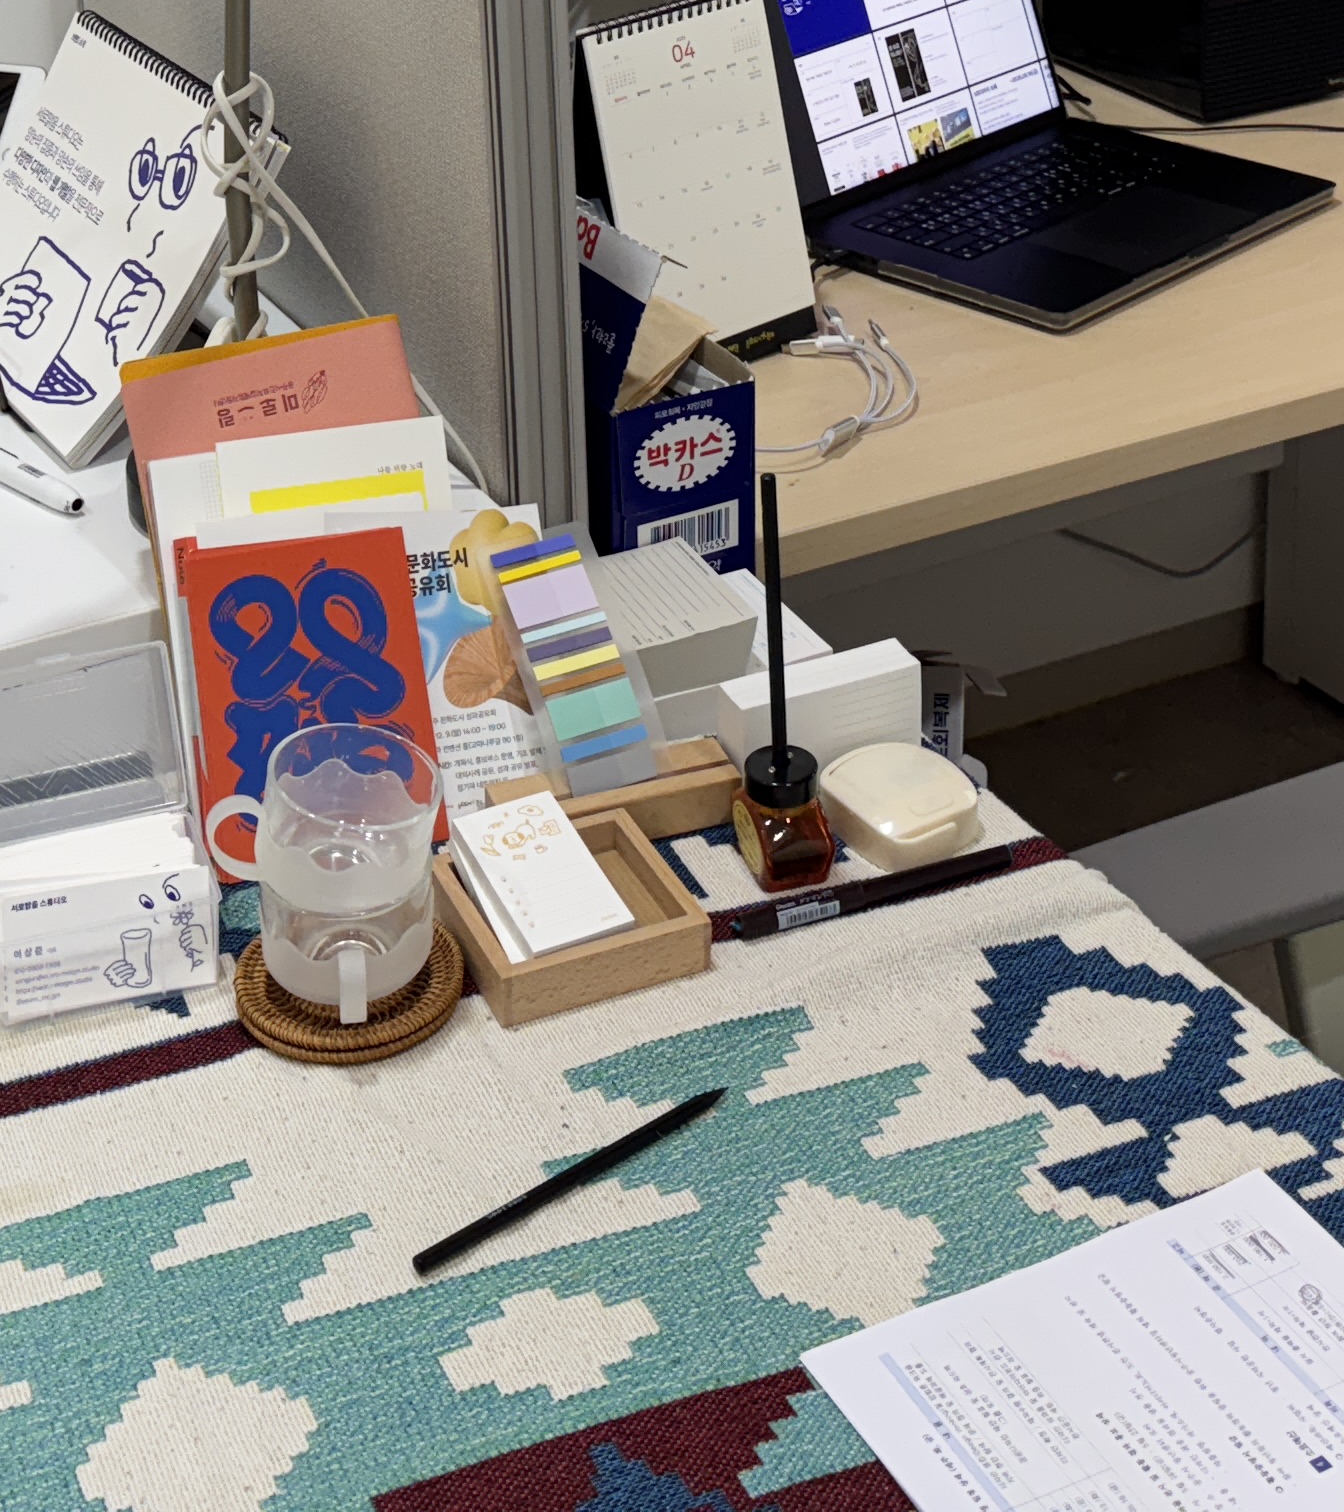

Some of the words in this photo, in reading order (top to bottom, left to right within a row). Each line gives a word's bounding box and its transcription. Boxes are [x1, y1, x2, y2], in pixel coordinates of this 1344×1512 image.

[672, 41, 695, 62] 04
[648, 432, 722, 467] 박카스
[678, 463, 694, 482] D
[406, 548, 468, 574] 문화도시
[40, 896, 68, 908] 스튜디오
